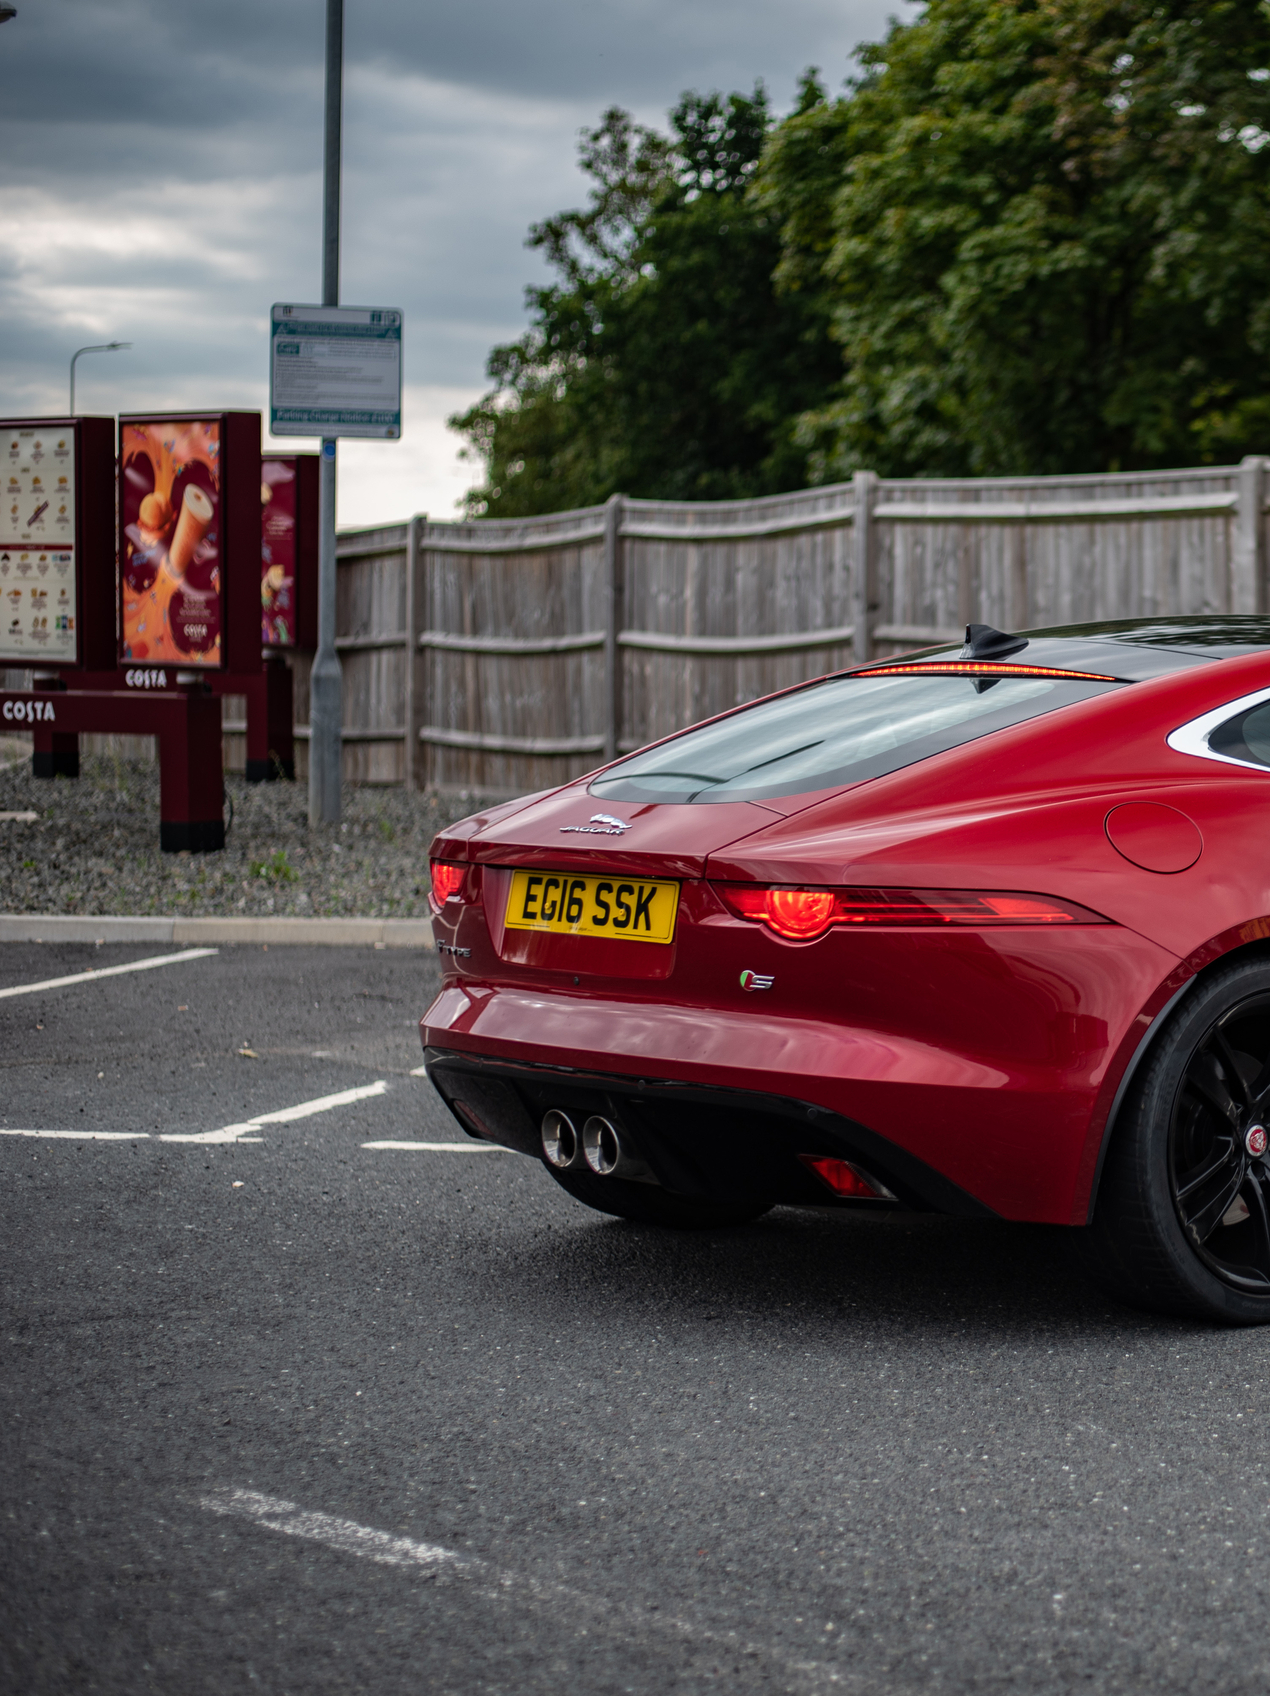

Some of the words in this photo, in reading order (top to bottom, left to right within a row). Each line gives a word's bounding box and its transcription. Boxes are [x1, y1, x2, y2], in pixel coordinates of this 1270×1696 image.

[183, 623, 208, 637] COSTA
[125, 669, 167, 689] COSTA
[2, 700, 56, 723] COSTA
[559, 825, 625, 836] JAGUAR
[522, 876, 587, 924] EG16
[592, 881, 657, 931] SSK
